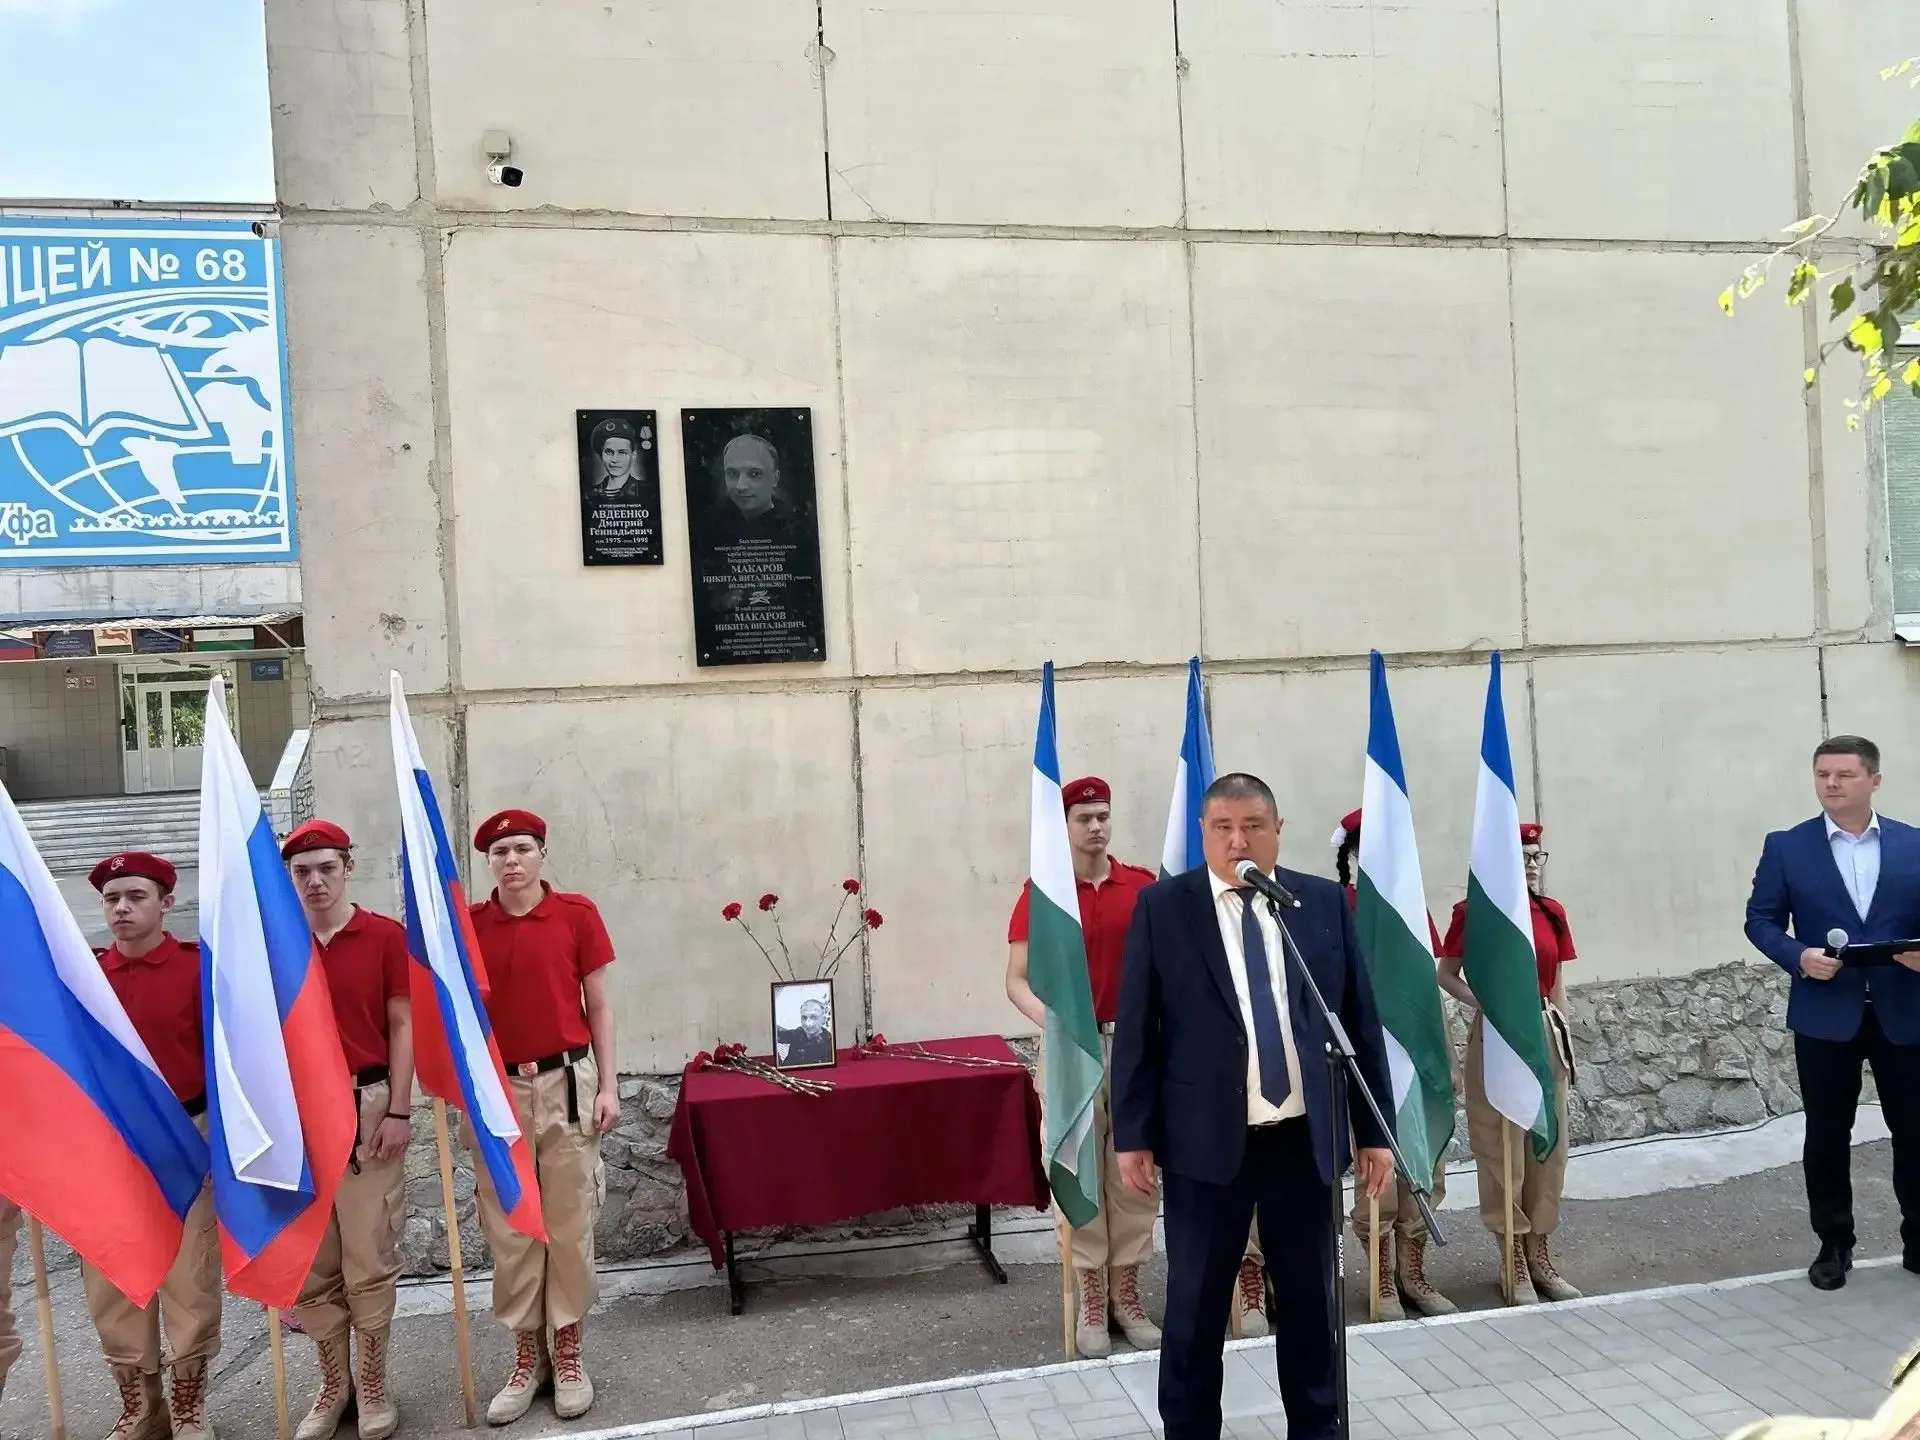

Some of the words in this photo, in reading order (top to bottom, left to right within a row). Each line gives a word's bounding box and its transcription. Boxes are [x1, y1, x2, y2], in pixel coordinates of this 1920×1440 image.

[0, 240, 112, 308] ЦЕЙ
[129, 247, 180, 283] №
[195, 248, 247, 282] 68
[591, 509, 649, 520] АВДЕЕНКО
[598, 518, 643, 529] Дмитрий
[589, 527, 653, 536] Геннадьевич
[633, 536, 649, 544] 1995
[731, 563, 784, 574] МАКАРОВ
[702, 575, 737, 583] НИКИТА
[738, 573, 793, 582] ВИТАЛЬЕВИЧ
[734, 611, 787, 622] МАКАРОВ
[715, 623, 749, 631] НИКИТА
